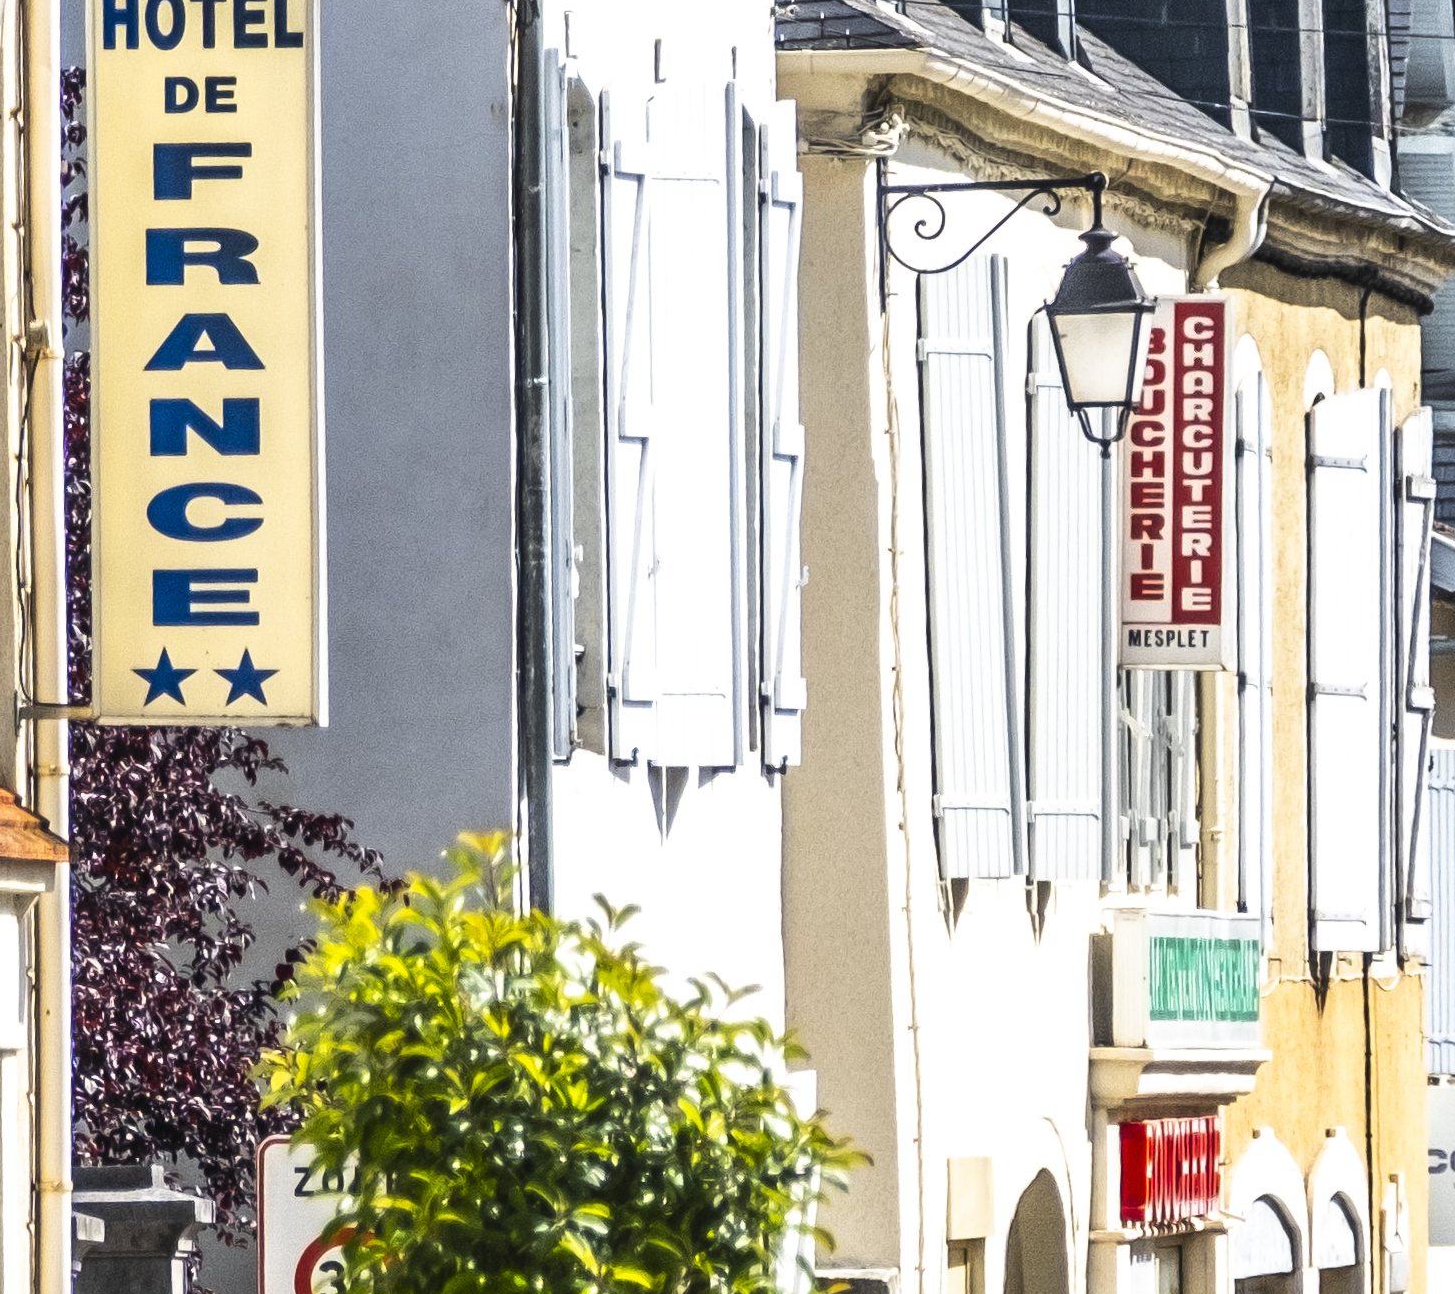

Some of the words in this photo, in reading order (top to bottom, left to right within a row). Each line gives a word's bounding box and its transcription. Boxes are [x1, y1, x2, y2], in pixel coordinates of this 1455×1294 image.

[163, 75, 239, 114] DE
[143, 142, 267, 628] FRANCE
[1181, 316, 1215, 611] CHARCUTERIE
[1127, 628, 1211, 649] MESPLET
